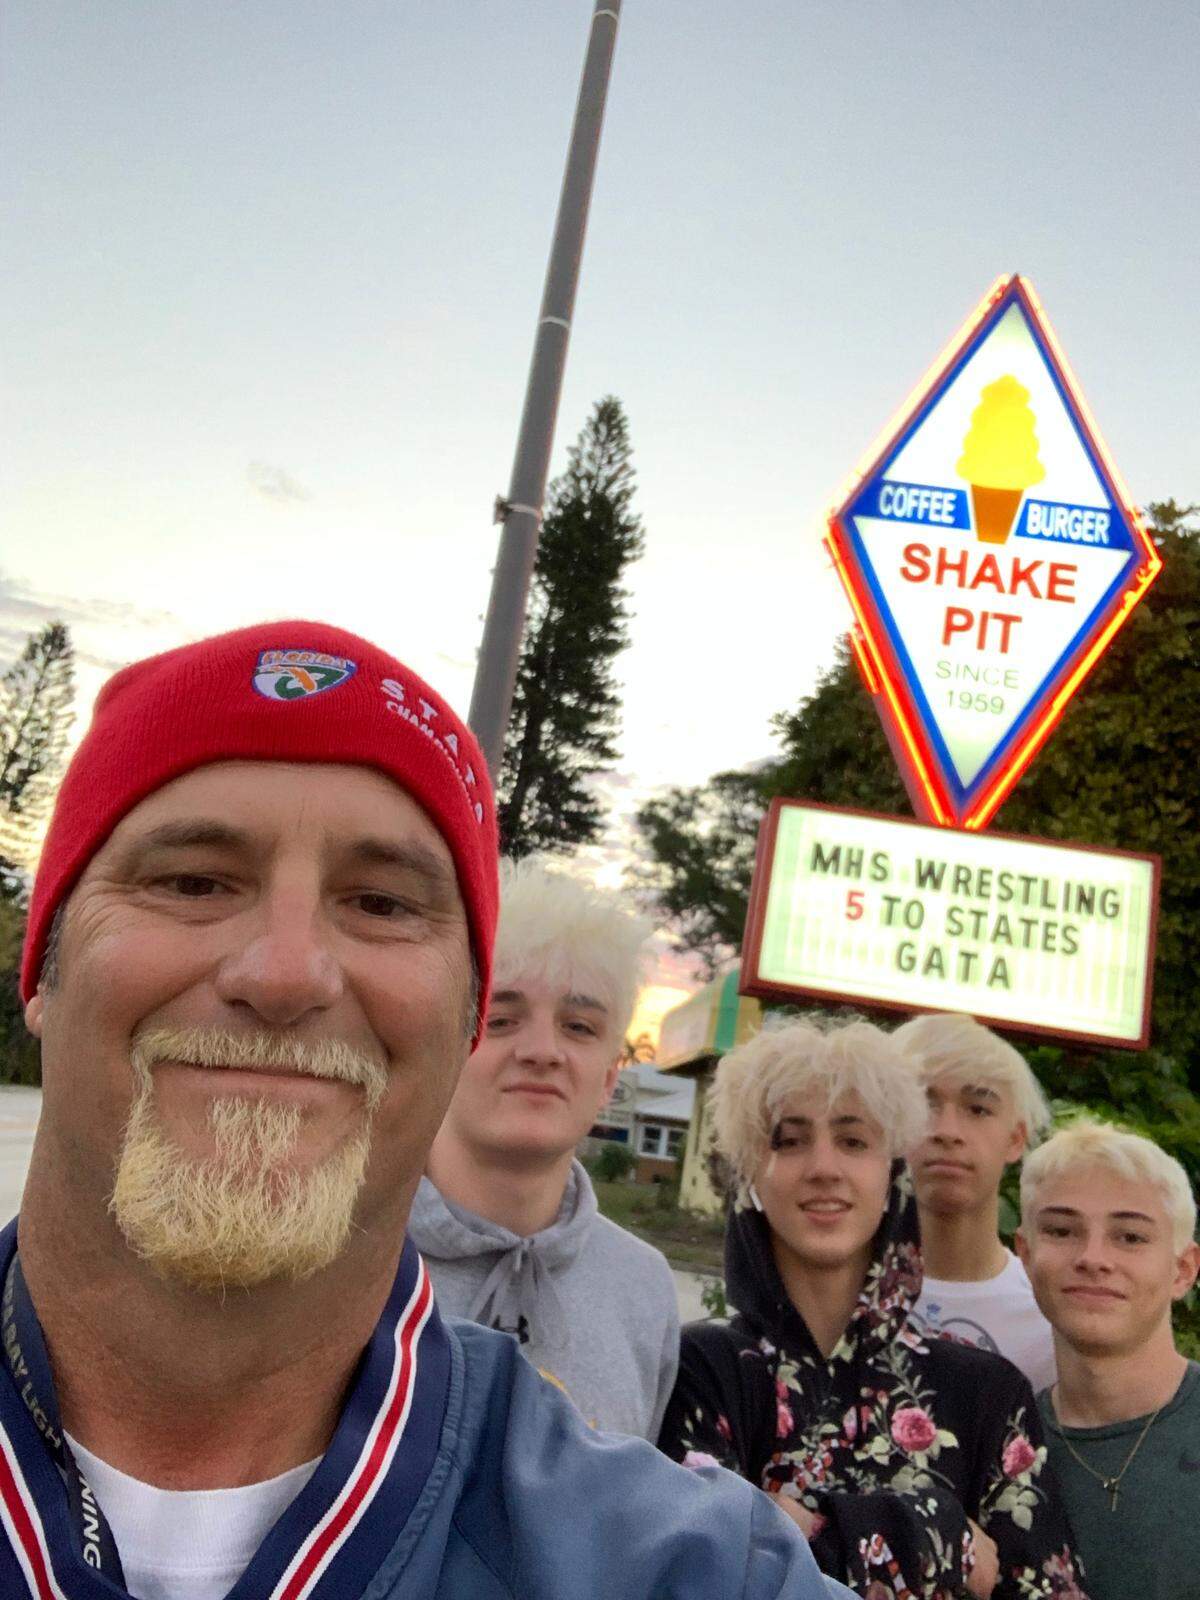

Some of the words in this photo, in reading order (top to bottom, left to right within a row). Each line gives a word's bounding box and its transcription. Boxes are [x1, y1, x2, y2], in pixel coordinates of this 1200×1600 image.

[879, 486, 956, 524] COFFEE
[1026, 502, 1111, 544] BURGER
[899, 543, 1078, 604] SHAKE
[941, 606, 1023, 654] PIT
[935, 660, 1020, 690] SINCE
[946, 690, 1005, 716] 1959
[810, 842, 889, 882] MHS
[915, 858, 1121, 919] WRESTLING
[845, 891, 866, 921] 5
[882, 895, 925, 930] TO
[944, 906, 1079, 955] STATES
[896, 941, 1011, 990] GATA
